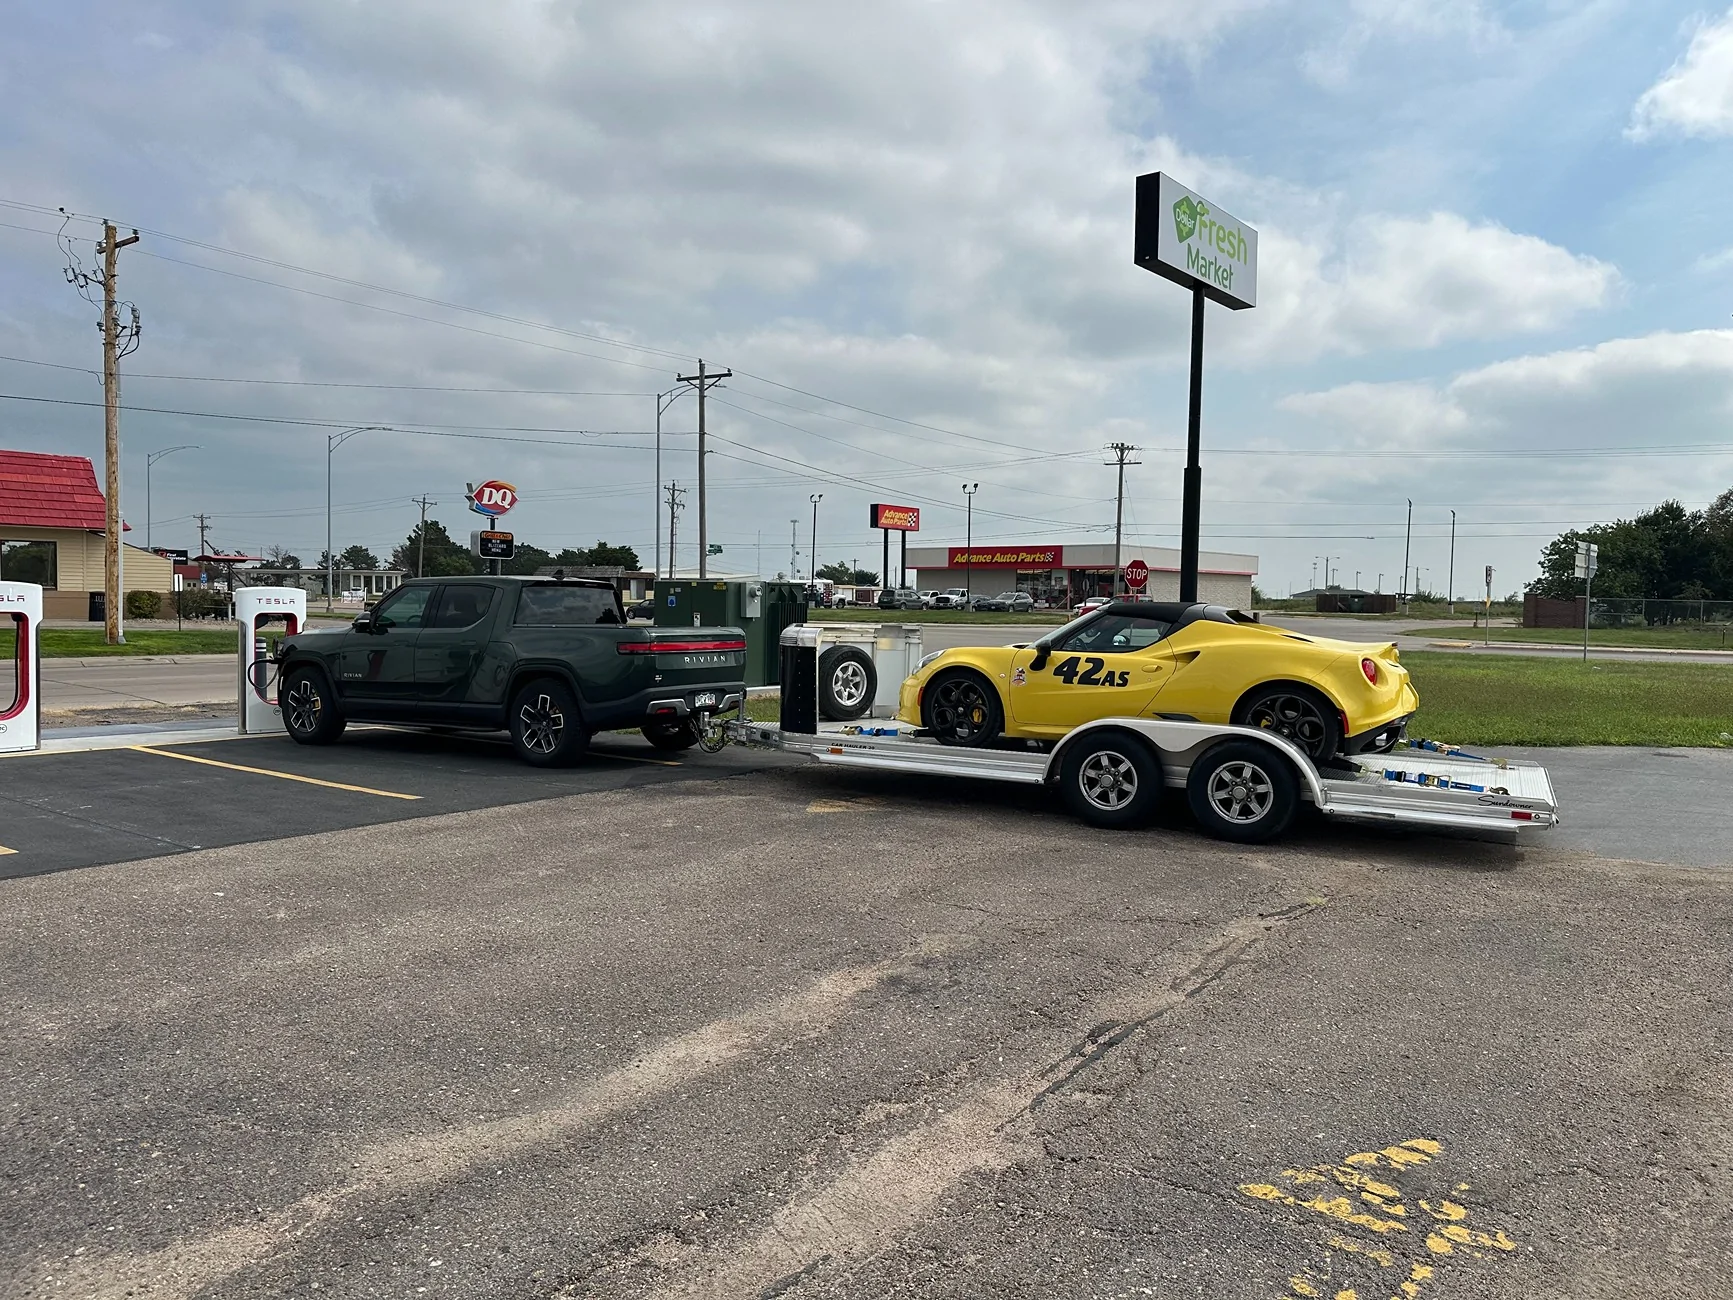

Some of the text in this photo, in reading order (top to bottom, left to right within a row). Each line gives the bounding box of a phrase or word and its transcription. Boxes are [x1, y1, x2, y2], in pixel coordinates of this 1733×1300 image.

[1175, 208, 1195, 229] Dollar
[1187, 243, 1234, 290] Market
[481, 487, 512, 509] DQ
[884, 510, 908, 519] Advance
[893, 518, 908, 526] Parts
[992, 552, 1017, 563] Auto
[1017, 552, 1045, 562] Parts
[1126, 568, 1148, 580] STOP
[684, 655, 726, 664] RIVIAN
[1477, 795, 1534, 809] Sundowner
